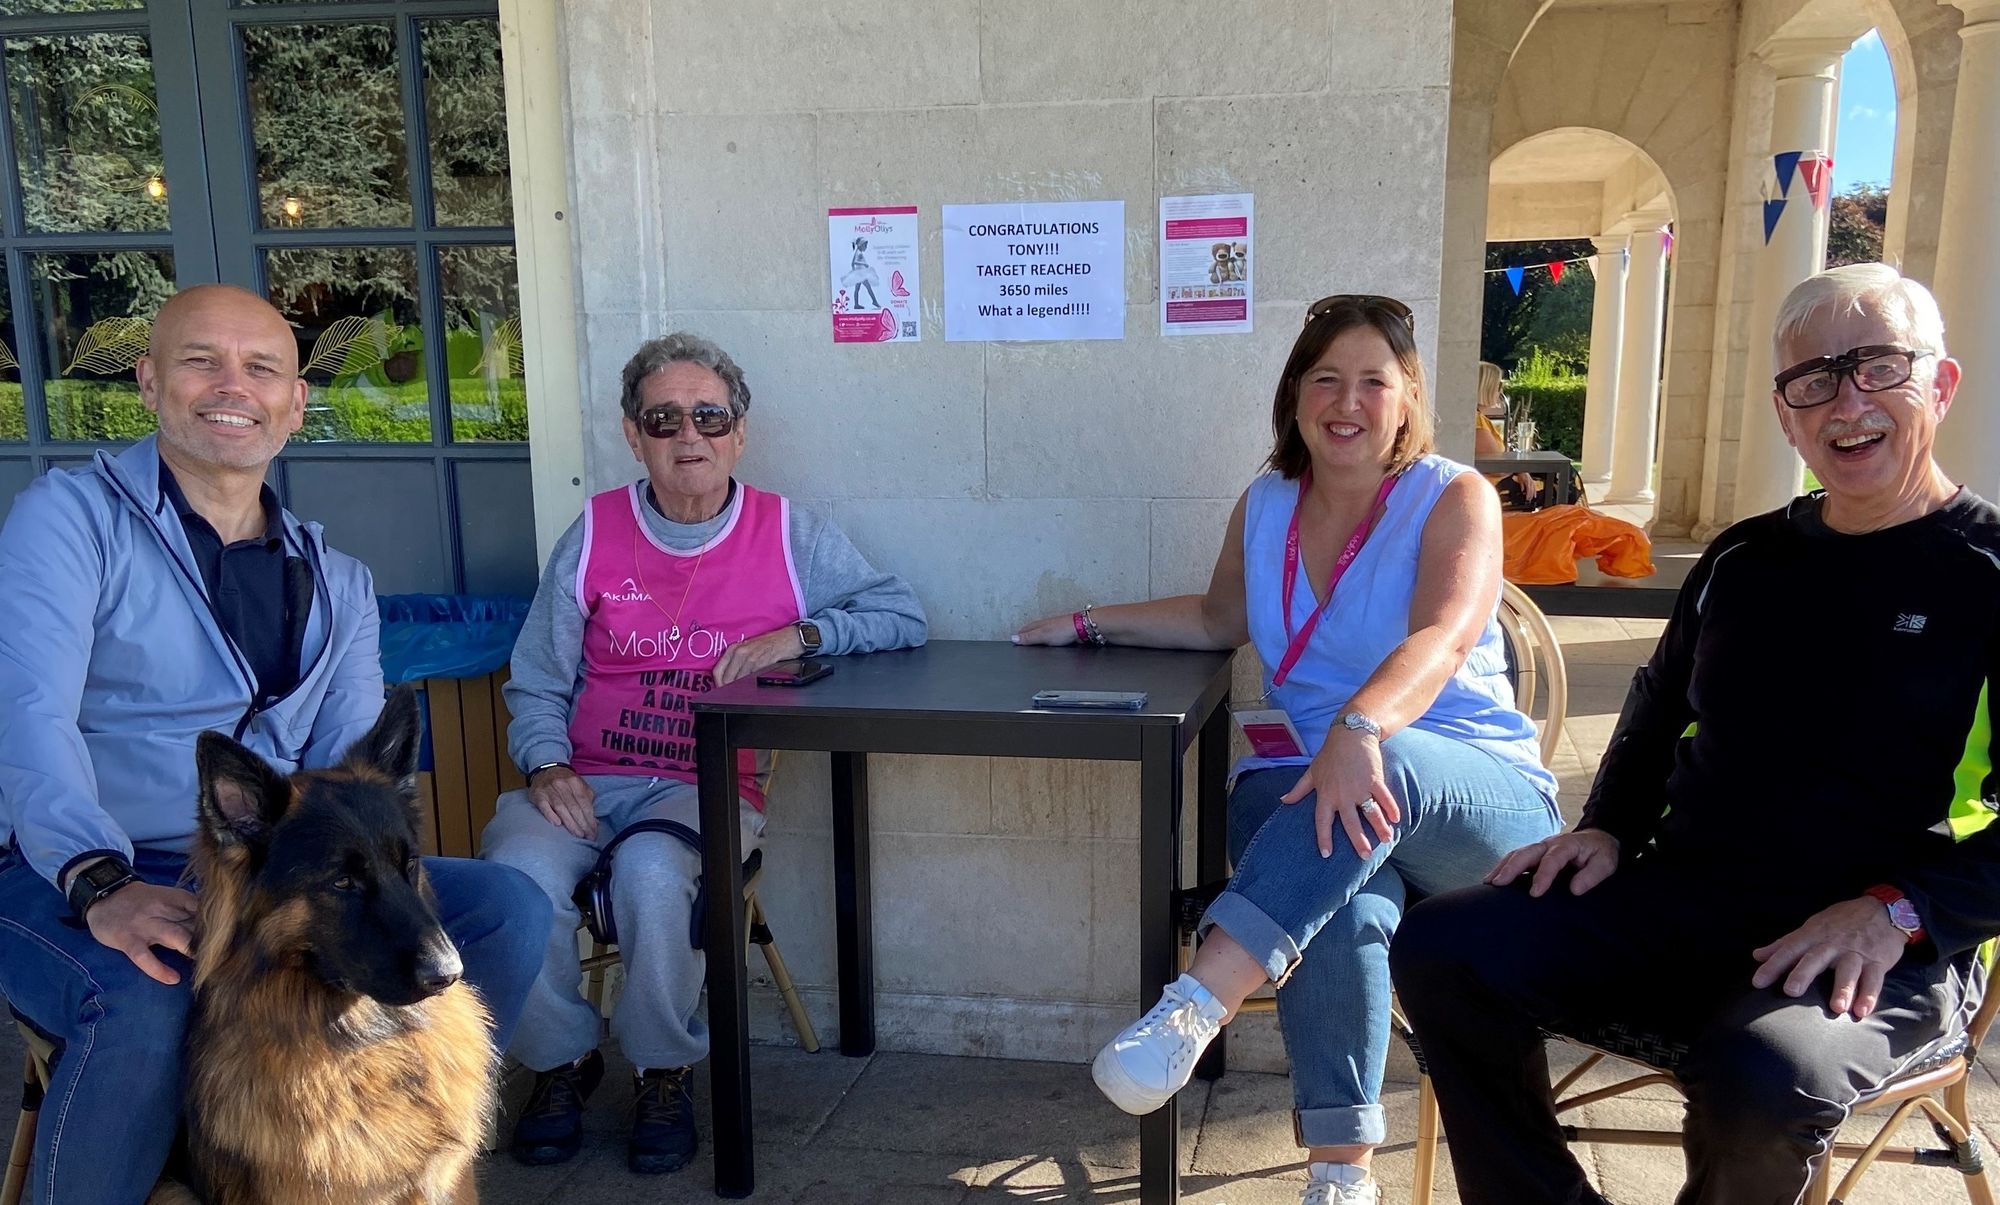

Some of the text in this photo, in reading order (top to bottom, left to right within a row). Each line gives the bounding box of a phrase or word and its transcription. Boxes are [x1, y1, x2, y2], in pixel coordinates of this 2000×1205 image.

[968, 222, 1099, 237] CONGRATULATIONS
[1007, 243, 1059, 256] TONY!!!
[976, 263, 1091, 277] TARGET REACHED
[999, 283, 1068, 296] 3650 miles
[978, 303, 1090, 319] What a legend!!!!
[602, 591, 652, 602] AKUMA
[609, 629, 684, 662] Molly
[640, 670, 713, 693] 10 MILES
[642, 689, 655, 708] A
